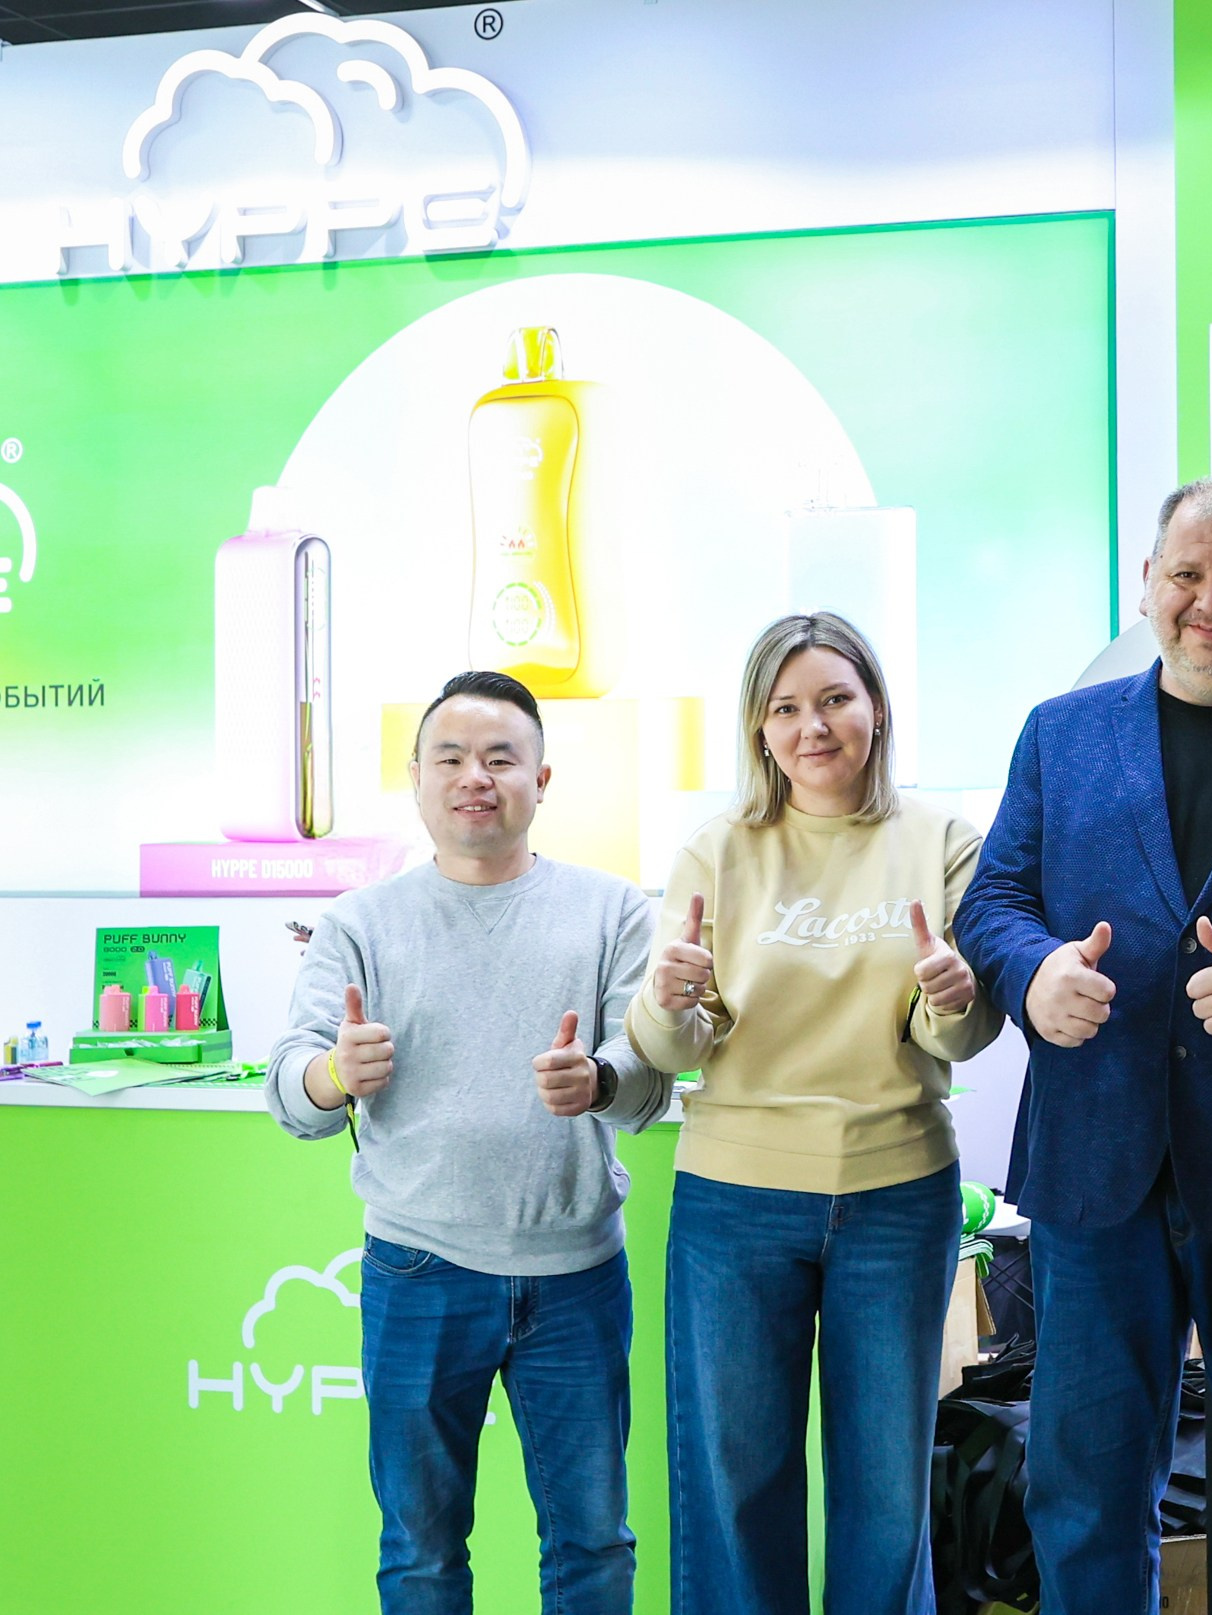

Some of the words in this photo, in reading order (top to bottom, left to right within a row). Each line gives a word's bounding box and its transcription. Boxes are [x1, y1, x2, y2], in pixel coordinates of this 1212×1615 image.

[56, 182, 502, 276] HYPPE
[0, 678, 105, 708] БЫТИЙ
[211, 859, 258, 879] HYPPE
[103, 934, 138, 944] PUFF
[142, 934, 186, 944] BUNNY
[844, 932, 876, 946] 1933
